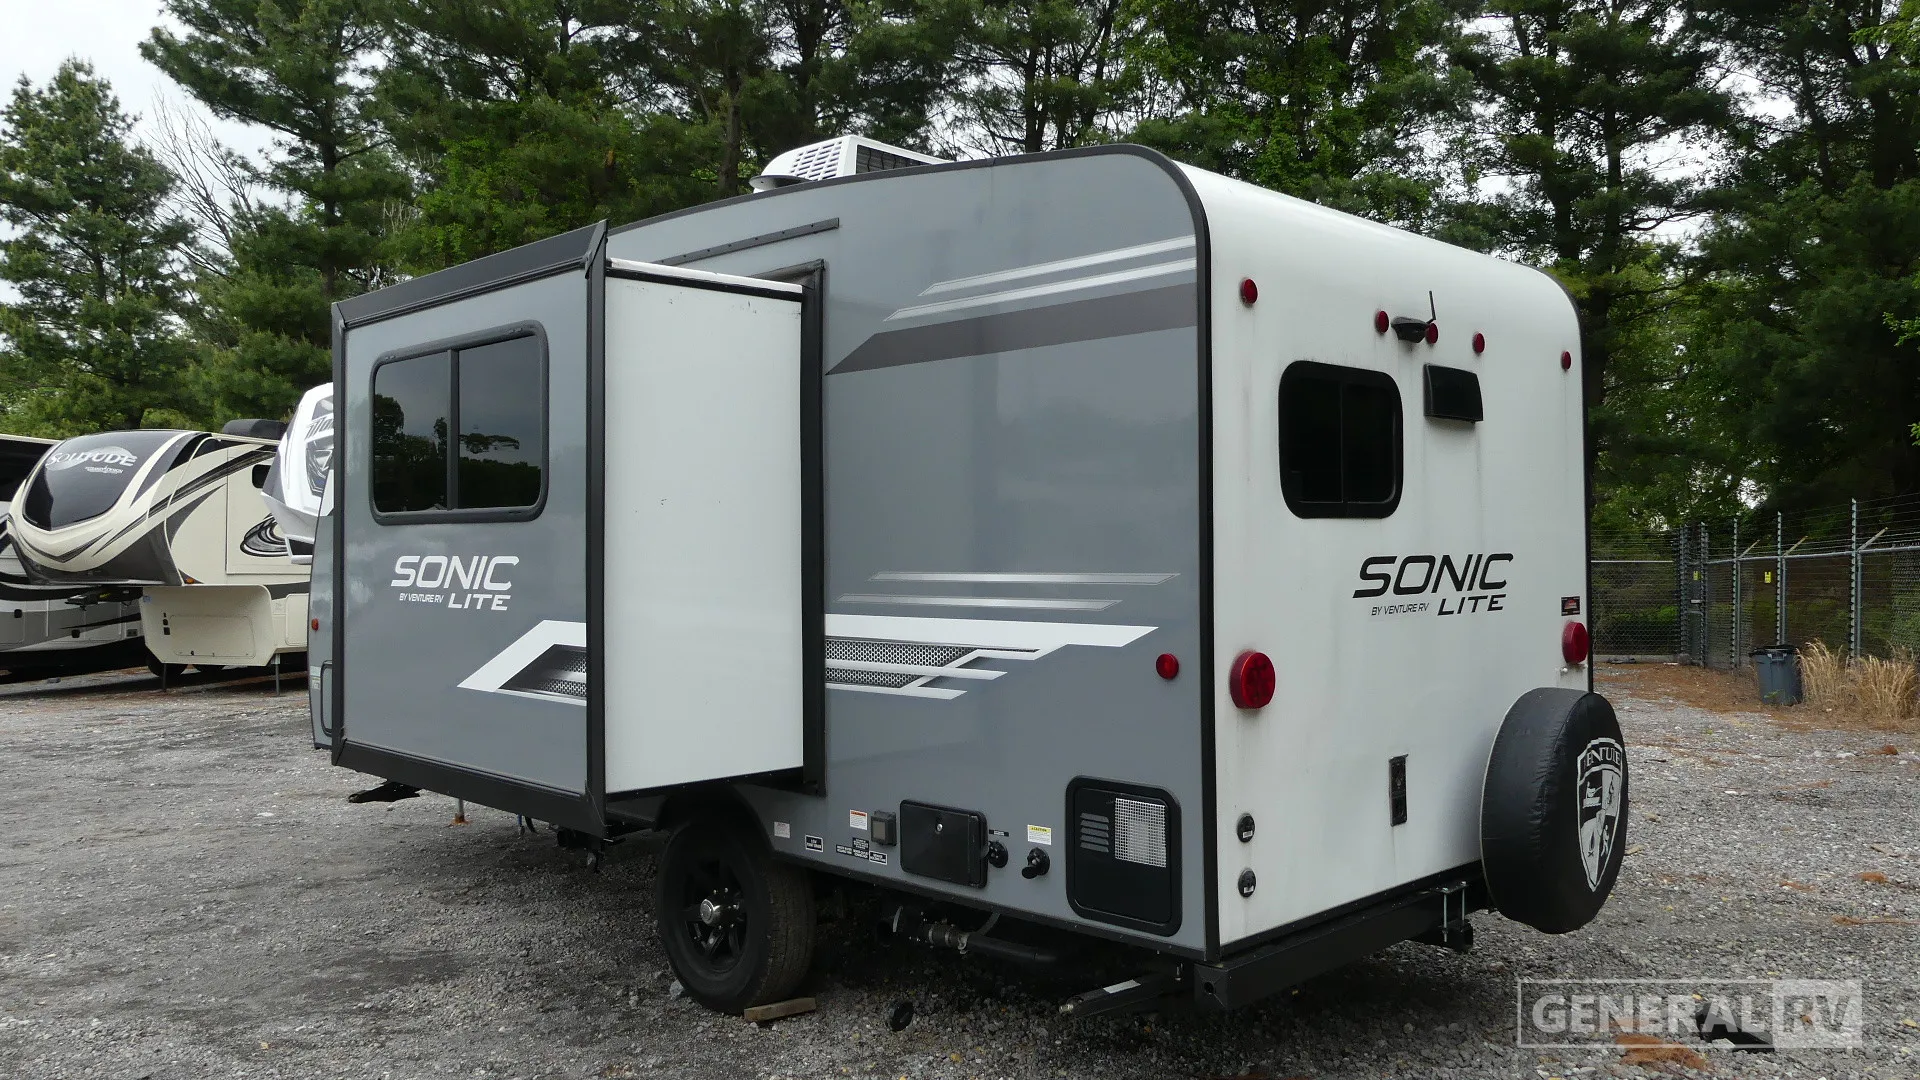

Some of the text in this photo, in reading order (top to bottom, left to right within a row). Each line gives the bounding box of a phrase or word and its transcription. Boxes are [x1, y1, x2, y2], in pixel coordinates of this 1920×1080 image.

[45, 452, 138, 467] SOLITUDE
[391, 556, 520, 591] SONIC
[1352, 553, 1514, 598] SONIC
[399, 592, 445, 603] BY VENTURE RV
[448, 593, 511, 611] LITE
[1437, 594, 1507, 616] LITE
[1371, 602, 1430, 616] BY VENTURE RV
